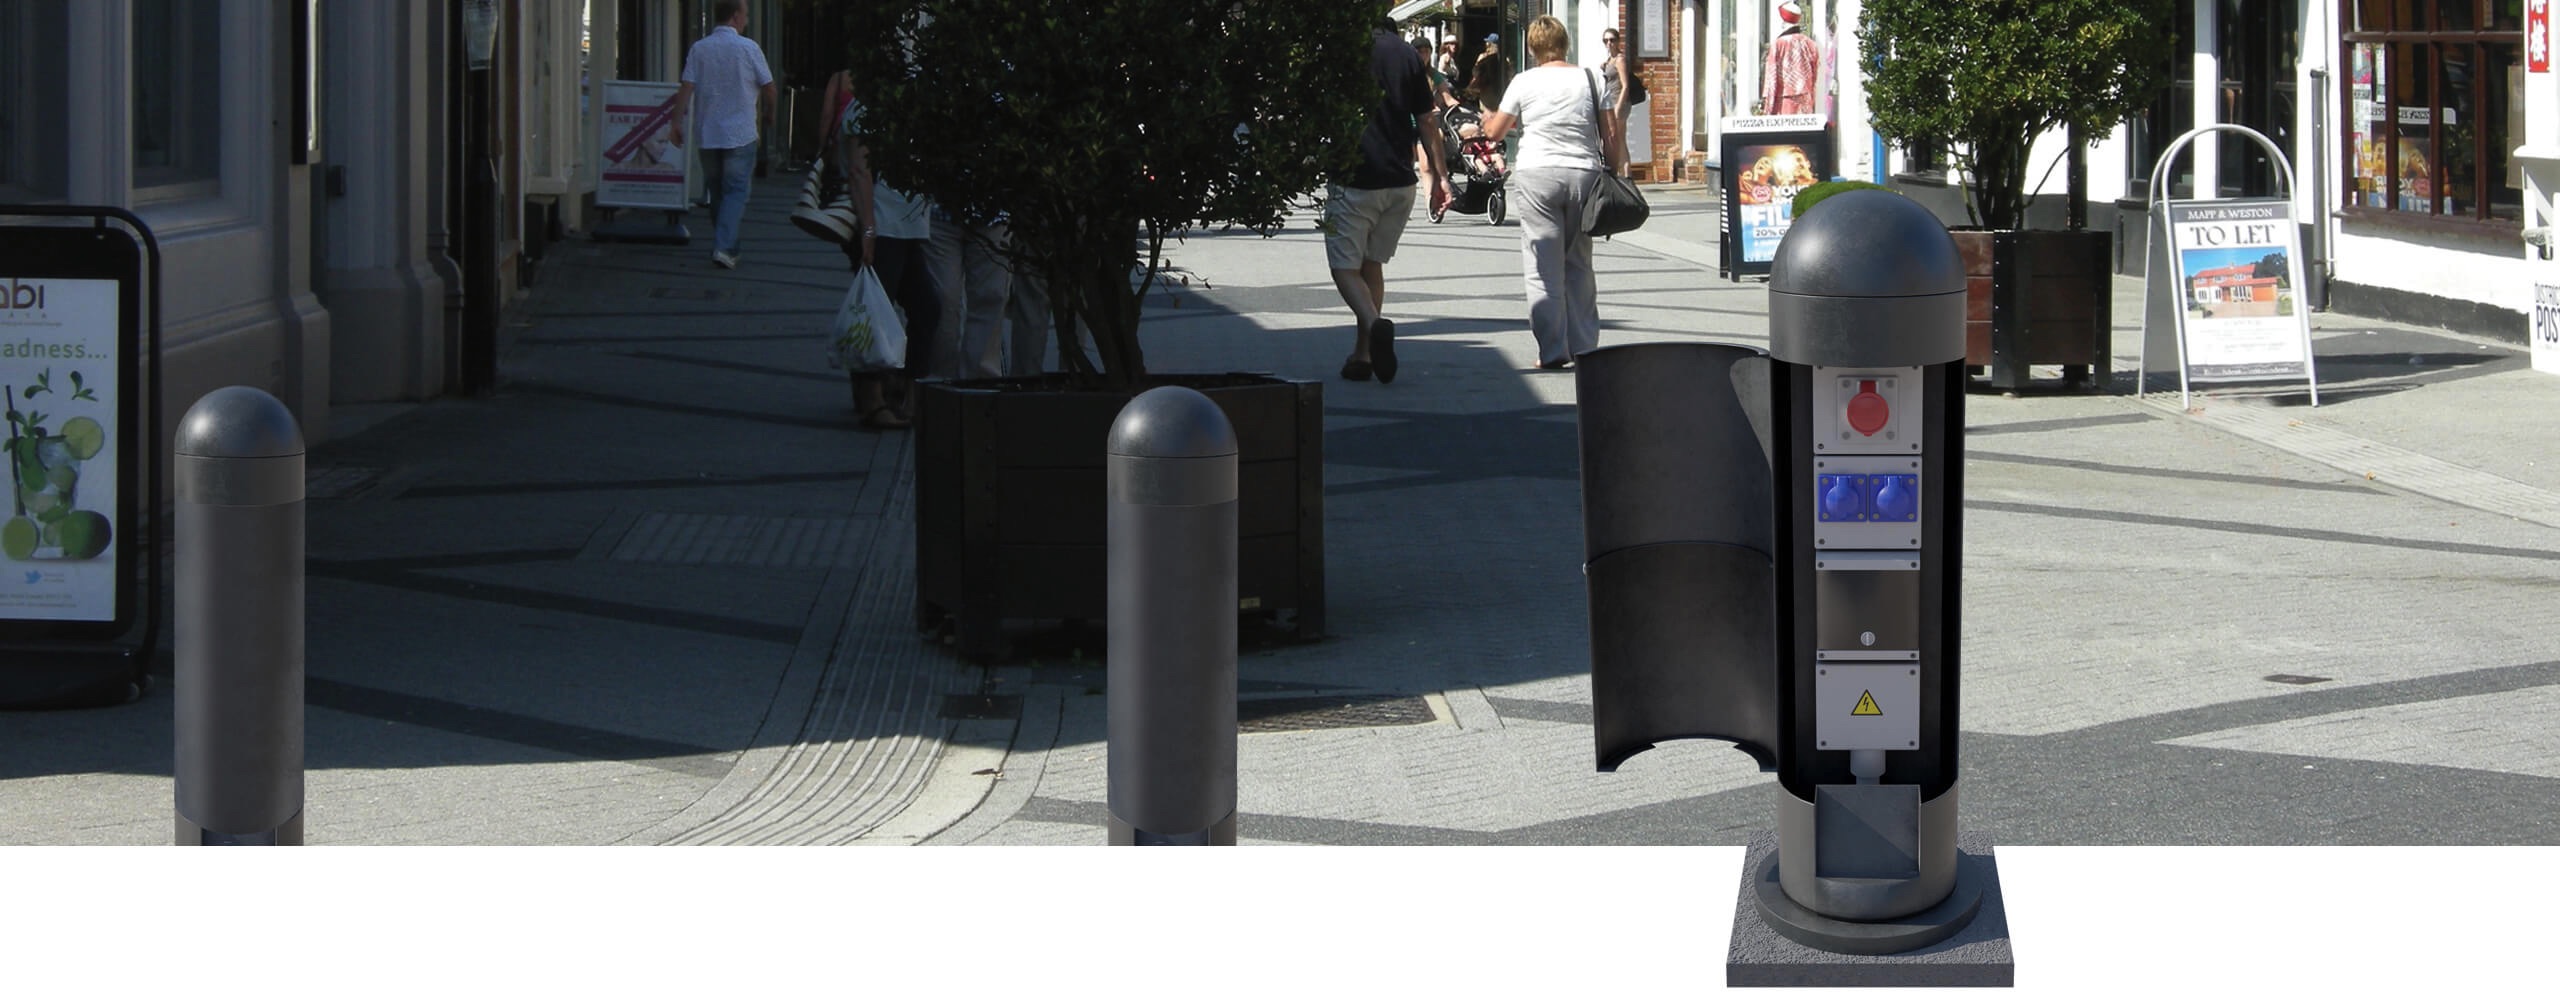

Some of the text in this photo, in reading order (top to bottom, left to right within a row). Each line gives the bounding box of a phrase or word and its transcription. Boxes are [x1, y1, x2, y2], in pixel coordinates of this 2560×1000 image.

[1732, 117, 1818, 129] PIZZA EXPRESS
[2188, 207, 2273, 220] MAPP & WESTON
[2189, 223, 2276, 246] TO LET
